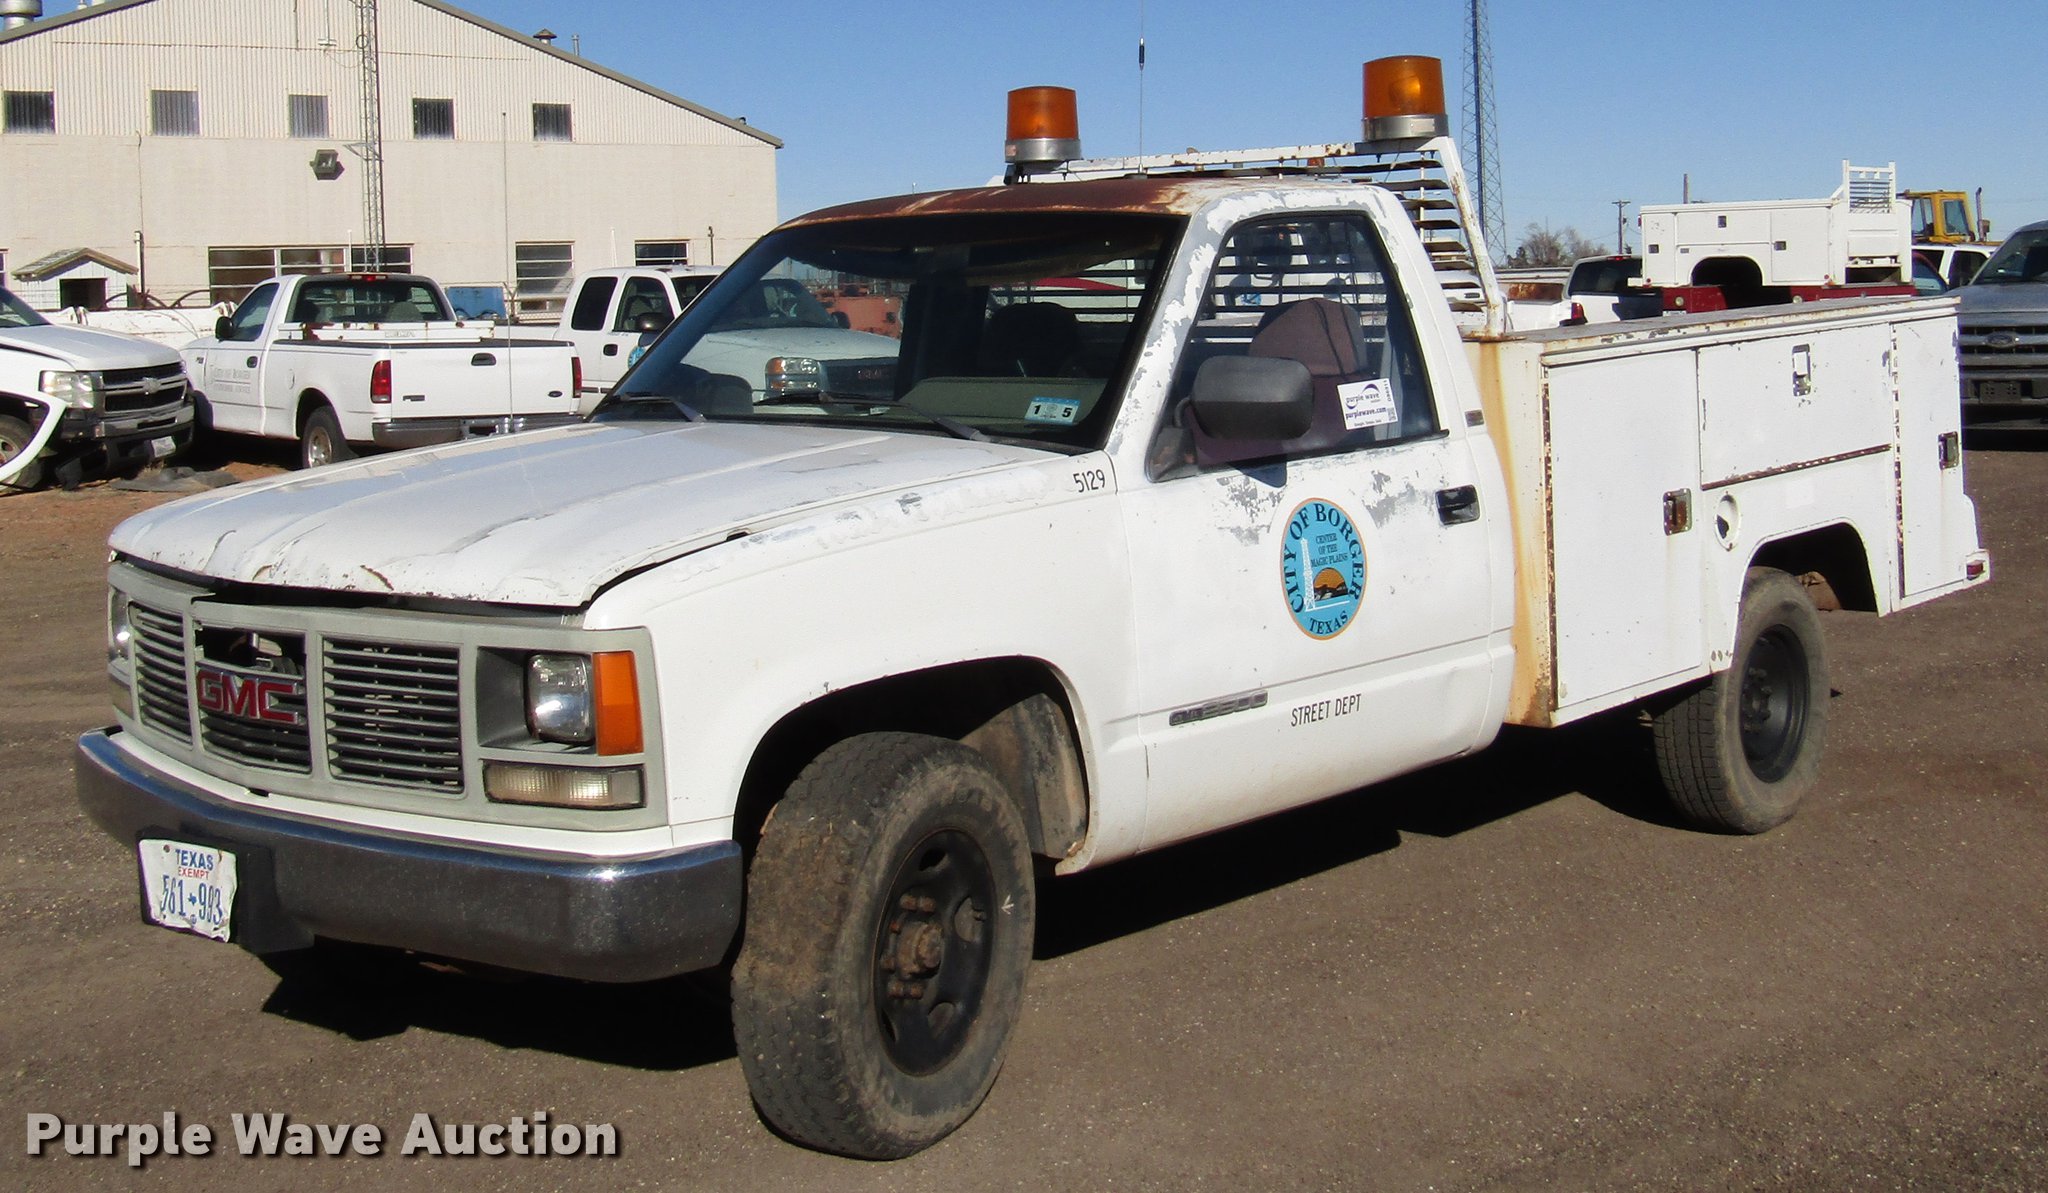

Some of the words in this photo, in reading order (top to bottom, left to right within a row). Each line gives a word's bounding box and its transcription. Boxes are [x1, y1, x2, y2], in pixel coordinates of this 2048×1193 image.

[1073, 469, 1105, 493] 5129
[1289, 506, 1309, 540] OF
[1314, 503, 1364, 600] BORGER
[1283, 544, 1304, 613] CITY
[1310, 610, 1348, 635] TEXAS
[196, 669, 299, 725] GMC
[1290, 699, 1332, 727] STREET
[1335, 693, 1362, 716] DEPT
[175, 848, 214, 871] TEXAS
[178, 866, 210, 880] EXEMPT
